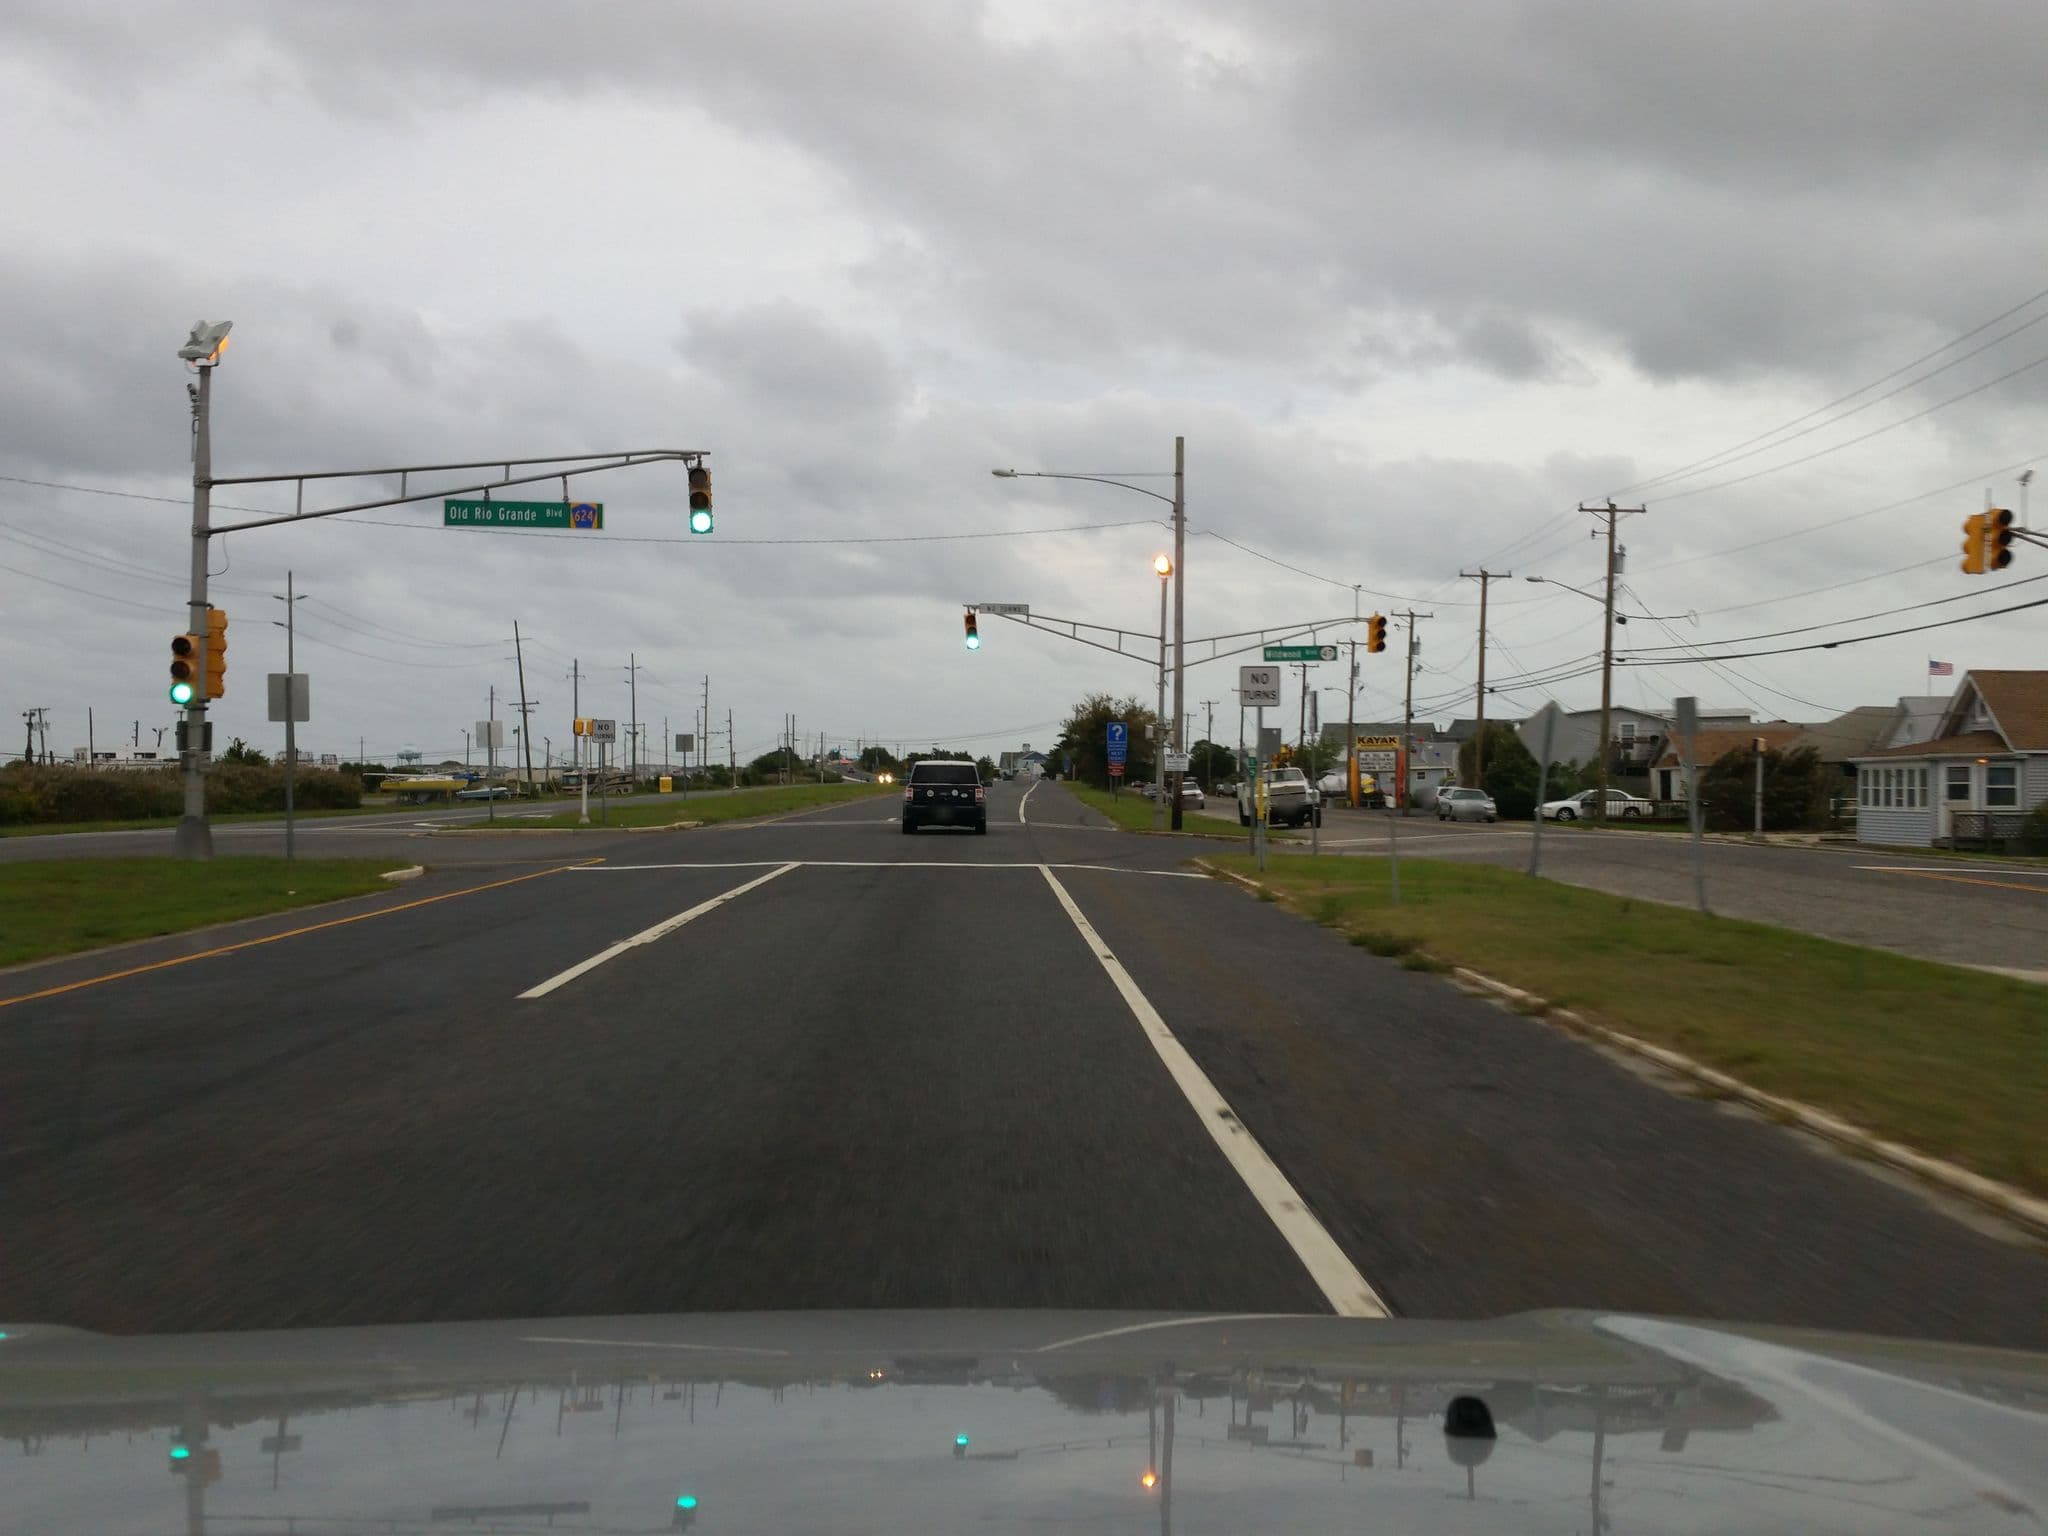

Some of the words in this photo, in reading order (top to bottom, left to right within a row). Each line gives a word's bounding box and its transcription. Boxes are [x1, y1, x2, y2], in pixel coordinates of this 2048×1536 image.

[450, 506, 468, 520] Old
[474, 507, 492, 520] Rio
[498, 508, 537, 521] Grande
[545, 509, 563, 518] Blvd
[574, 510, 593, 522] 624
[1265, 649, 1302, 659] Wildwood
[1250, 673, 1270, 685] NO
[1243, 690, 1277, 700] TURNS
[597, 723, 610, 731] NO
[1357, 736, 1398, 745] KAYAK
